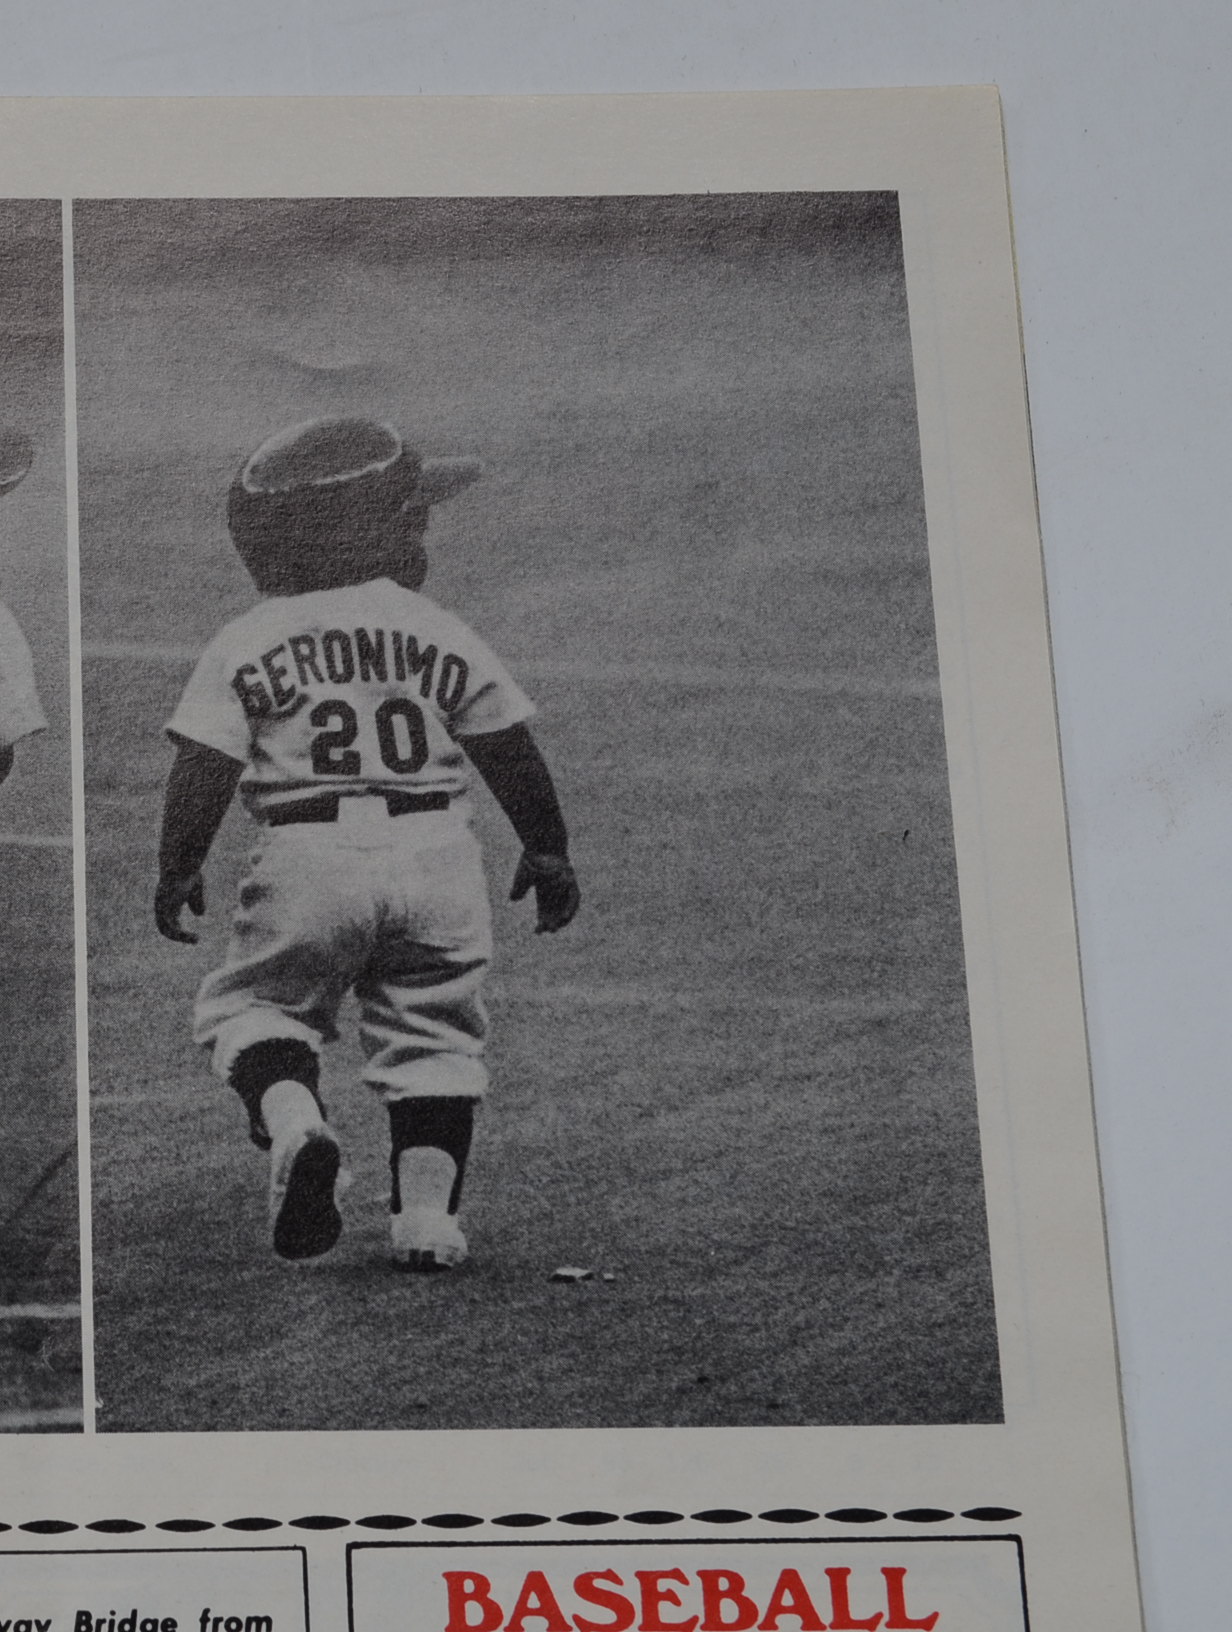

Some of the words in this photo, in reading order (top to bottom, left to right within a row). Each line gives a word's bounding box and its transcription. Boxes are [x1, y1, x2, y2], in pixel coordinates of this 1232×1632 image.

[231, 627, 469, 717] GERONIMO
[309, 698, 429, 775] 20
[199, 1608, 273, 1632] from
[442, 1567, 939, 1632] BASEBALL
